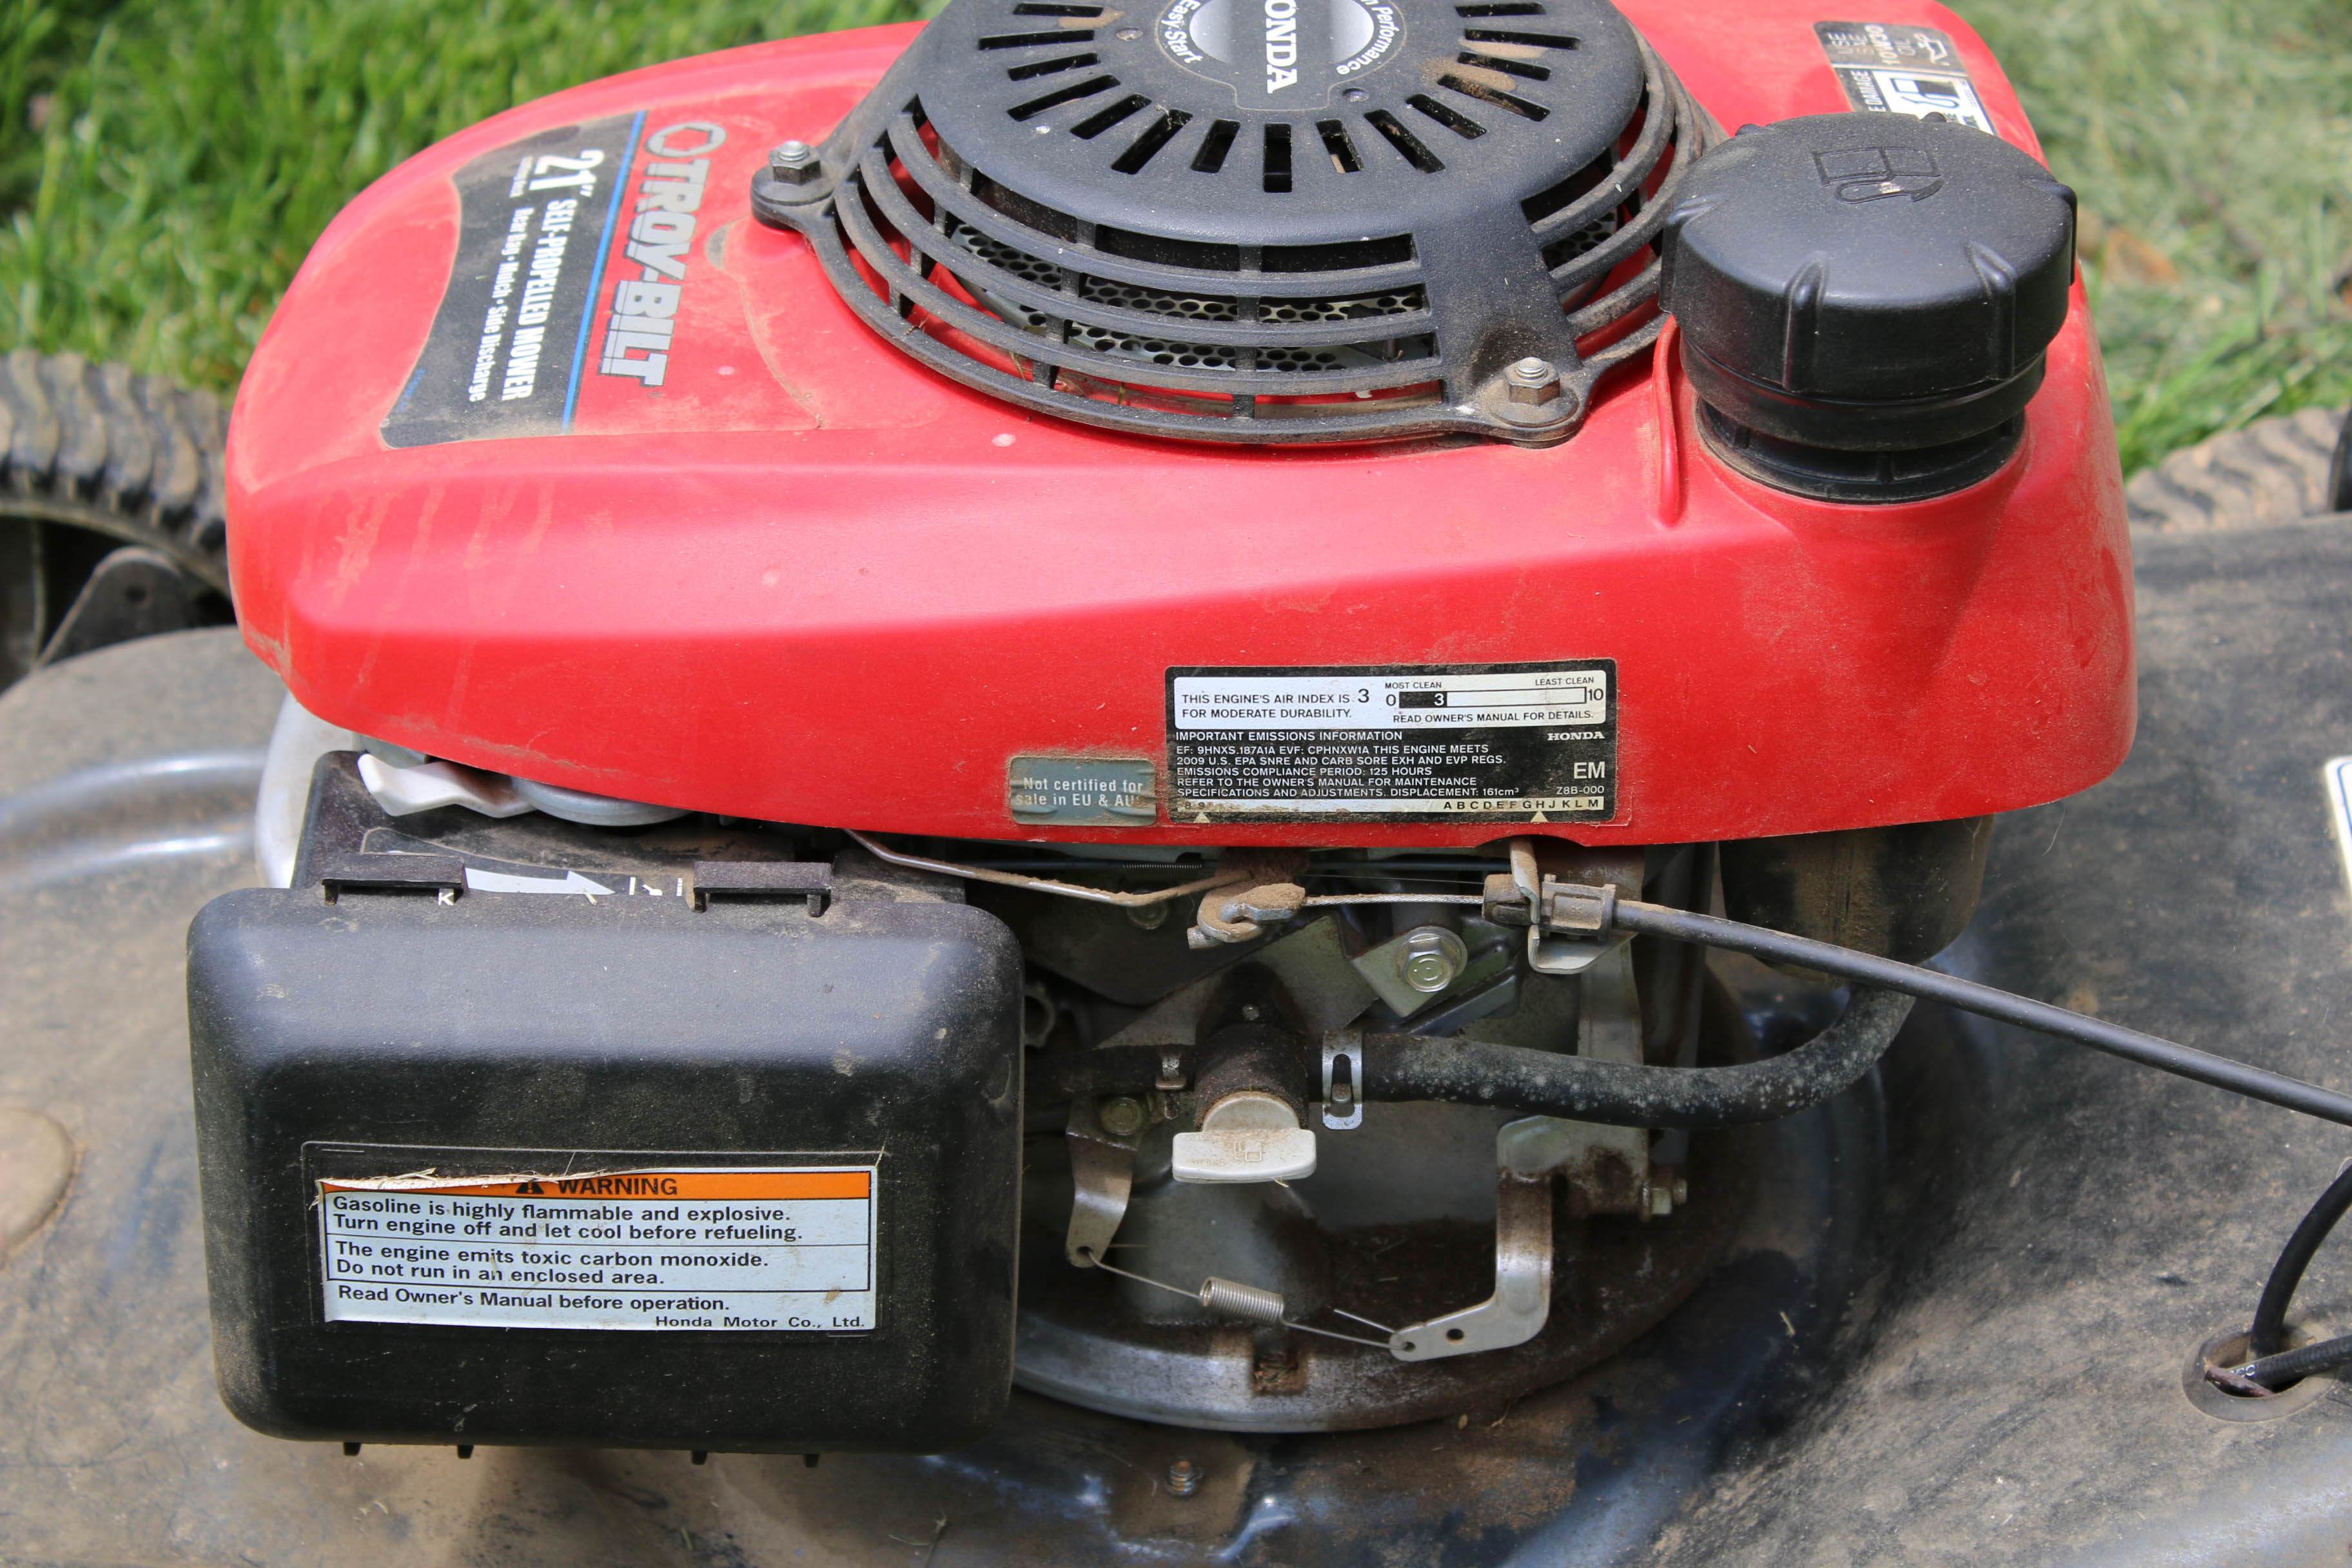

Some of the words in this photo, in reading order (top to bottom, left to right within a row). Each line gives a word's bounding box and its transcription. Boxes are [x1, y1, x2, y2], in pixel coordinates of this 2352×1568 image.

[1161, 0, 1201, 28] Easy
[1164, 30, 1204, 64] Start
[1336, 6, 1400, 75] Performance
[1850, 70, 1883, 105] DAMAGE
[509, 207, 534, 233] Rear
[501, 233, 527, 256] Bag
[518, 197, 578, 326] SELF-PROPELLED
[492, 261, 519, 299] Mulch
[598, 158, 711, 387] TROY-BILT
[484, 305, 509, 334] Side
[468, 333, 502, 402] Discharge
[502, 326, 545, 401] MOWER
[1565, 676, 1594, 685] CLEAN
[1182, 694, 1210, 703] THIS
[1215, 694, 1270, 703] ENGINE'S
[1274, 694, 1293, 703] AIR
[1298, 694, 1334, 703] INDEX
[1338, 694, 1350, 703] IS
[1357, 688, 1369, 703] 3
[1433, 693, 1445, 706] 3
[1587, 688, 1603, 701] 10
[1182, 709, 1206, 718] FOR
[1211, 709, 1276, 718] MODERATE
[1280, 709, 1351, 718] DURABILITY.
[1393, 714, 1422, 723] READ
[1426, 713, 1473, 722] OWNER'S
[1477, 712, 1520, 721] MANUAL
[1524, 712, 1544, 720] FOR
[1548, 710, 1594, 720] DETAILS.
[1175, 732, 1244, 741] IMPORTANT
[1248, 732, 1315, 741] EMISSIONS
[1320, 731, 1402, 741] INFORMATION
[1547, 731, 1605, 741] HONDA
[1176, 746, 1193, 754] EF:
[1197, 745, 1275, 754] 9HNXS.187A1A
[1279, 746, 1304, 754] EVF:
[1308, 745, 1369, 754] CPHNXW1A
[1373, 745, 1399, 754] THIS
[1403, 745, 1446, 754] ENGINE
[1450, 744, 1489, 753] MEETS
[1177, 757, 1204, 765] 2009
[1209, 757, 1231, 765] U.S.
[1235, 757, 1256, 765] EPA
[1259, 757, 1290, 765] SNRE
[1294, 757, 1318, 765] AND
[1322, 756, 1353, 765] CARB
[1357, 756, 1387, 765] SORE
[1391, 756, 1414, 765] EXH
[1418, 756, 1442, 765] AND
[1446, 756, 1468, 764] EVP
[1471, 755, 1506, 763] REGS.
[1243, 767, 1316, 776] COMPLIANCE
[1320, 767, 1366, 776] PERIOD:
[1369, 767, 1387, 776] 125
[1573, 761, 1605, 779] EM
[1023, 778, 1048, 790] Not
[1054, 779, 1117, 792] certified
[1122, 779, 1143, 793] for
[1177, 778, 1213, 787] REFER
[1217, 778, 1233, 787] TO
[1237, 778, 1259, 787] THE
[1263, 778, 1314, 787] OWNER'S
[1318, 778, 1364, 786] MANUAL
[1368, 778, 1391, 786] FOR
[1395, 778, 1476, 786] MAINTENANCE
[1556, 786, 1605, 795] Z8B-000
[1015, 794, 1046, 805] sale
[1054, 794, 1066, 805] in
[1073, 794, 1091, 806] EU
[1099, 794, 1108, 807] &
[1115, 794, 1139, 807] AU
[1177, 789, 1269, 797] SPECIFICATIONS
[1273, 789, 1297, 797] AND
[1301, 789, 1386, 797] ADJUSTMENTS.
[1391, 788, 1478, 796] DISPLACEMENT:
[558, 1178, 677, 1195] WARNING
[333, 1196, 421, 1215] Gasoline
[429, 1200, 444, 1215] is
[453, 1201, 514, 1221] highly
[522, 1204, 633, 1221] flammable
[642, 1206, 679, 1221] and
[687, 1206, 790, 1224] explosive.
[333, 1214, 378, 1230] Turn
[387, 1218, 455, 1236] engine
[464, 1220, 492, 1235] off
[500, 1222, 536, 1238] and
[545, 1224, 571, 1238] let
[579, 1224, 621, 1239] cool
[630, 1225, 696, 1239] before
[705, 1224, 803, 1242] refueling.
[335, 1240, 373, 1257] The
[381, 1245, 449, 1262] engine
[458, 1248, 514, 1264] emits
[522, 1250, 571, 1265] toxic
[580, 1251, 652, 1266] carbon
[660, 1253, 769, 1267] monoxide.
[337, 1259, 364, 1275] Do
[372, 1262, 404, 1277] not
[411, 1266, 445, 1279] run
[453, 1265, 471, 1280] in
[478, 1269, 503, 1281] an
[511, 1269, 603, 1284] enclosed
[611, 1272, 664, 1284] area.
[338, 1286, 387, 1301] Read
[395, 1288, 473, 1306] Owner's
[480, 1292, 553, 1308] Manual
[560, 1295, 622, 1309] before
[631, 1297, 729, 1312] operation.
[655, 1317, 712, 1328] Honda
[723, 1317, 778, 1328] Motor
[789, 1317, 821, 1329] Co.,
[832, 1317, 865, 1328] Ltd.
